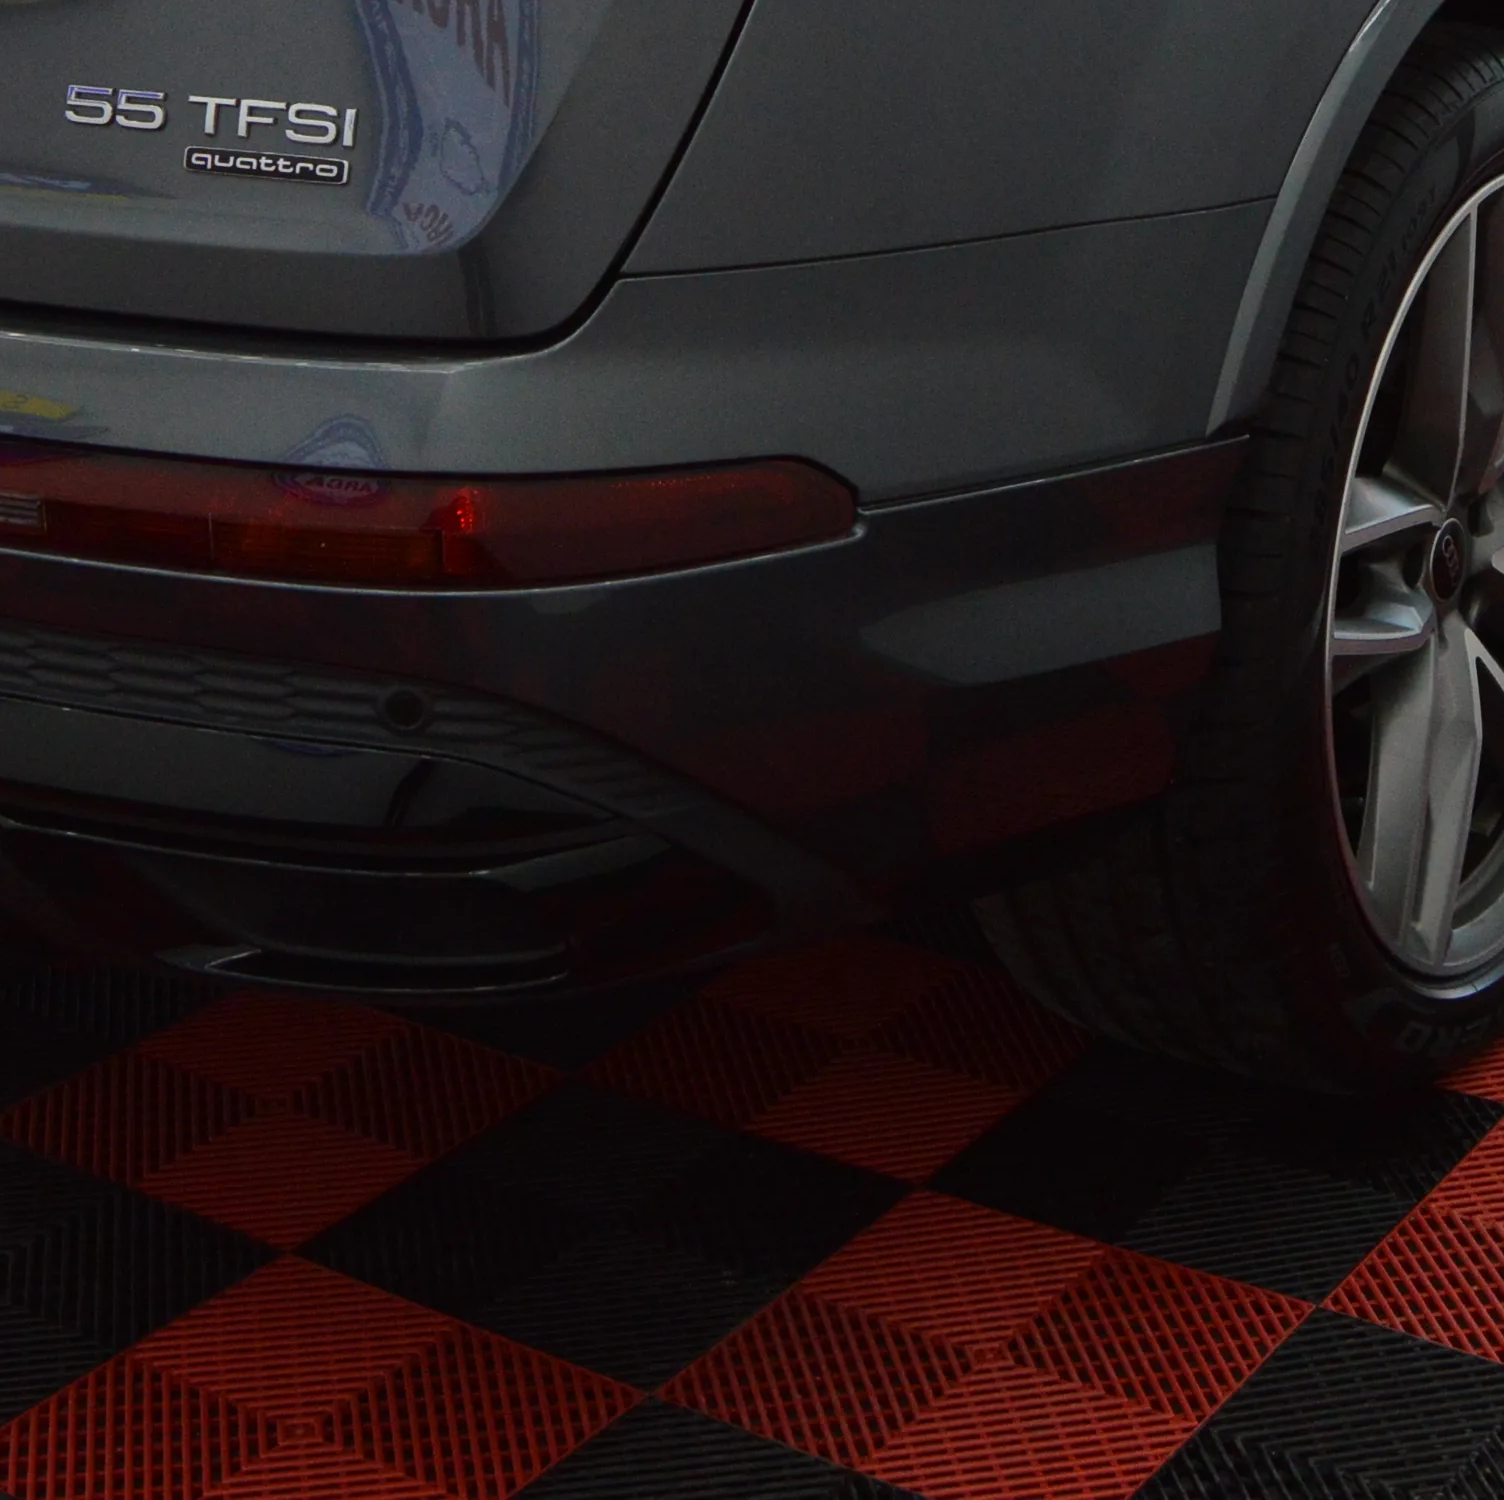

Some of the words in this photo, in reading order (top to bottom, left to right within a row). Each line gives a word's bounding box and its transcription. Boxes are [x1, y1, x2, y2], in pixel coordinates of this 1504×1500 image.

[64, 85, 165, 130] 55
[188, 95, 358, 147] TFSI
[190, 152, 339, 178] quattro
